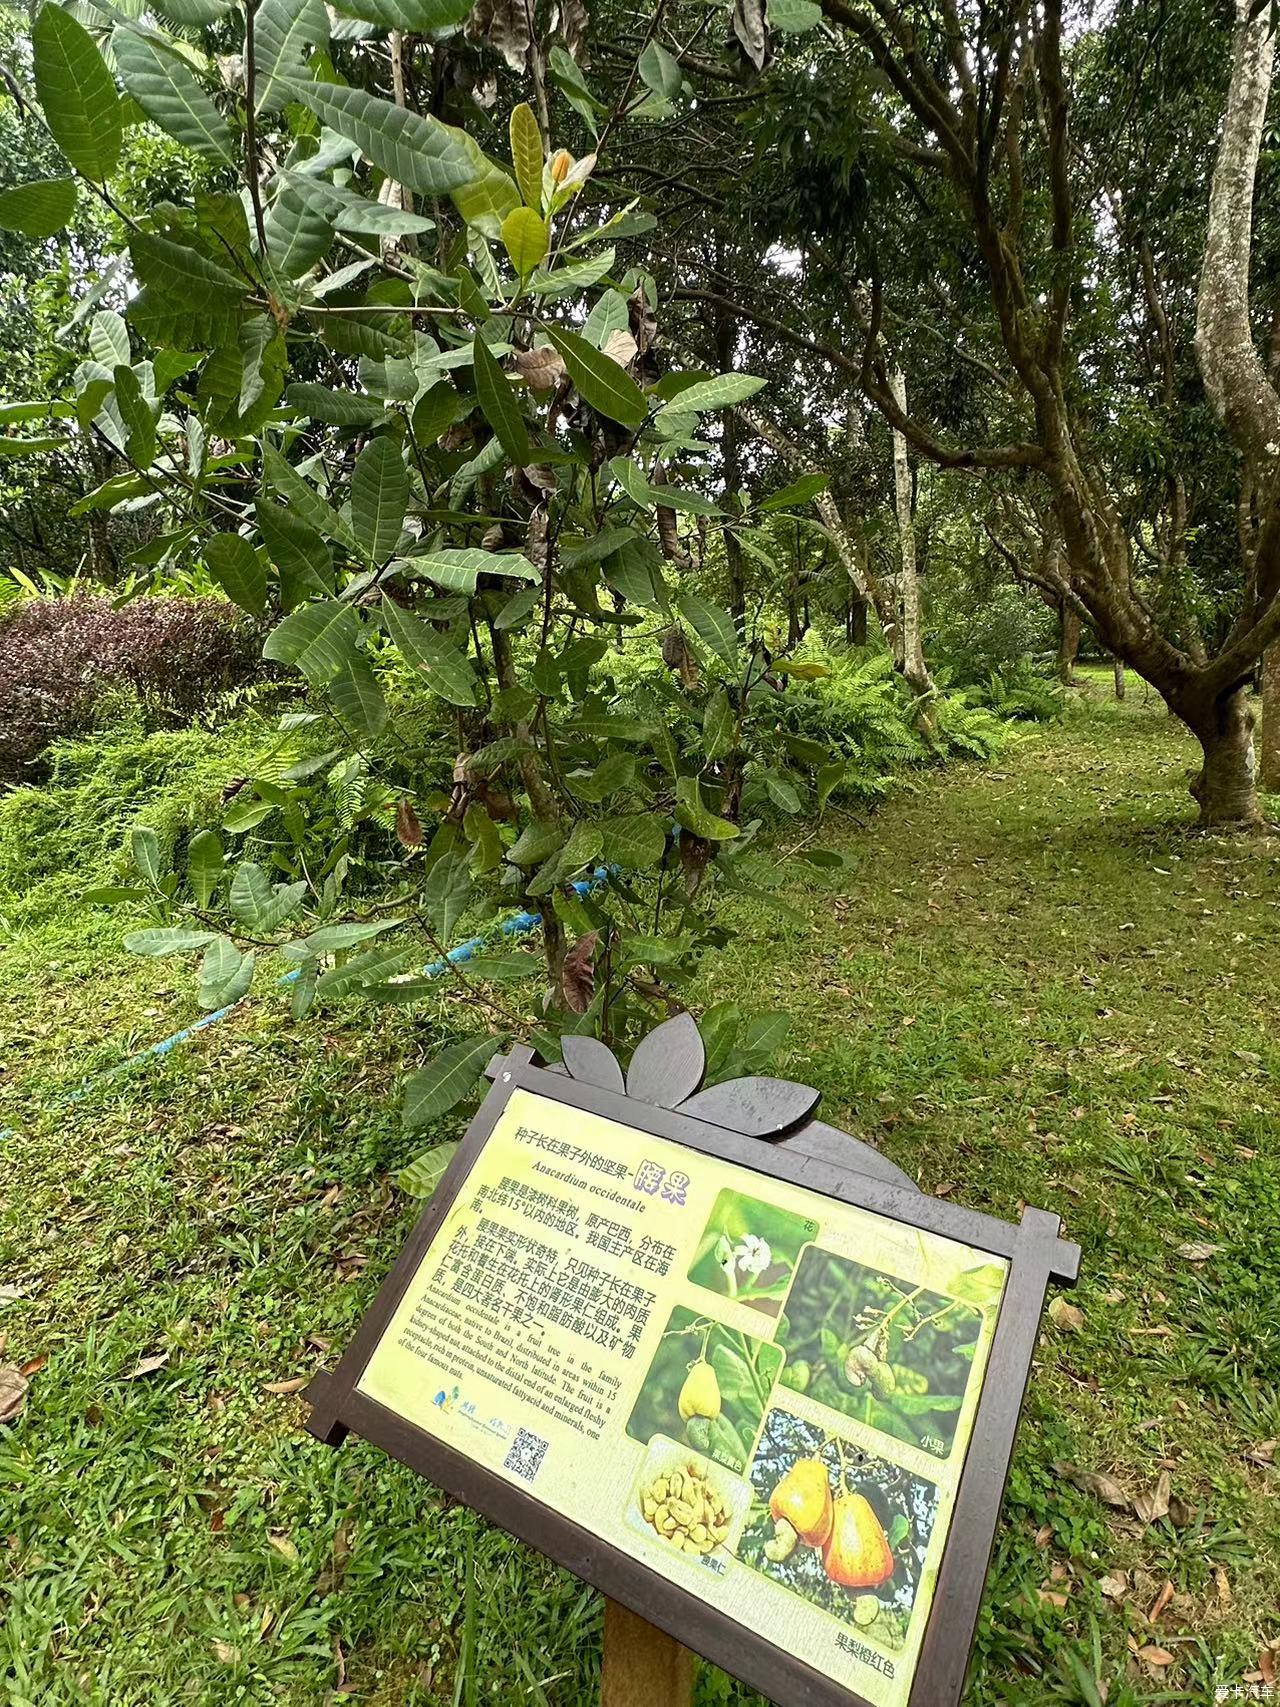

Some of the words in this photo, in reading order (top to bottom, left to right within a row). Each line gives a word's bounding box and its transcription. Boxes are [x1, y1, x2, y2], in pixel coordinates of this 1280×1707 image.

[531, 1160, 588, 1189] Anacardium
[588, 1184, 646, 1213] occidentale
[802, 1219, 815, 1233] 花
[397, 1337, 407, 1346] of
[404, 1340, 415, 1351] the
[414, 1345, 428, 1358] four
[427, 1353, 449, 1371] famous
[408, 1314, 450, 1342] kidney-shaped
[461, 1343, 488, 1362] attached
[486, 1357, 494, 1366] to
[494, 1360, 505, 1372] the
[504, 1366, 524, 1382] distal
[523, 1377, 537, 1389] end
[535, 1384, 546, 1393] of
[544, 1389, 553, 1398] an
[553, 1393, 584, 1416] enlarged
[582, 1408, 606, 1429] fleshy
[414, 1303, 437, 1321] degrees
[438, 1317, 447, 1325] of
[447, 1320, 461, 1333] both
[462, 1329, 473, 1339] the
[474, 1335, 494, 1350] South
[495, 1347, 508, 1358] and
[509, 1353, 529, 1369] North
[561, 1380, 575, 1394] The
[577, 1389, 593, 1404] fruit
[595, 1399, 603, 1409] is
[420, 1293, 462, 1321] Anacardiaceae,
[463, 1316, 483, 1331] native
[484, 1327, 492, 1335] to
[492, 1330, 514, 1348] Brazil,
[515, 1342, 551, 1366] distributed
[552, 1361, 560, 1371] in
[561, 1368, 579, 1382] areas
[582, 1377, 604, 1395] within
[606, 1389, 617, 1401] 15
[426, 1283, 461, 1305] Anacardium
[465, 1303, 500, 1325] occidentale
[503, 1323, 511, 1331] is
[526, 1333, 542, 1347] fruit
[547, 1344, 560, 1356] tree
[566, 1353, 575, 1364] in
[580, 1361, 592, 1373] the
[597, 1370, 622, 1390] family
[402, 1326, 433, 1349] receptacle,
[432, 1342, 446, 1354] rich
[445, 1350, 453, 1358] in
[451, 1354, 475, 1373] protein,
[475, 1366, 513, 1391] unsaturated
[511, 1385, 541, 1408] fattyacid
[540, 1402, 555, 1414] and
[553, 1409, 585, 1433] minerals,
[586, 1428, 600, 1440] one
[918, 1431, 946, 1456] 小果
[833, 1629, 898, 1681] 果梨橙红色
